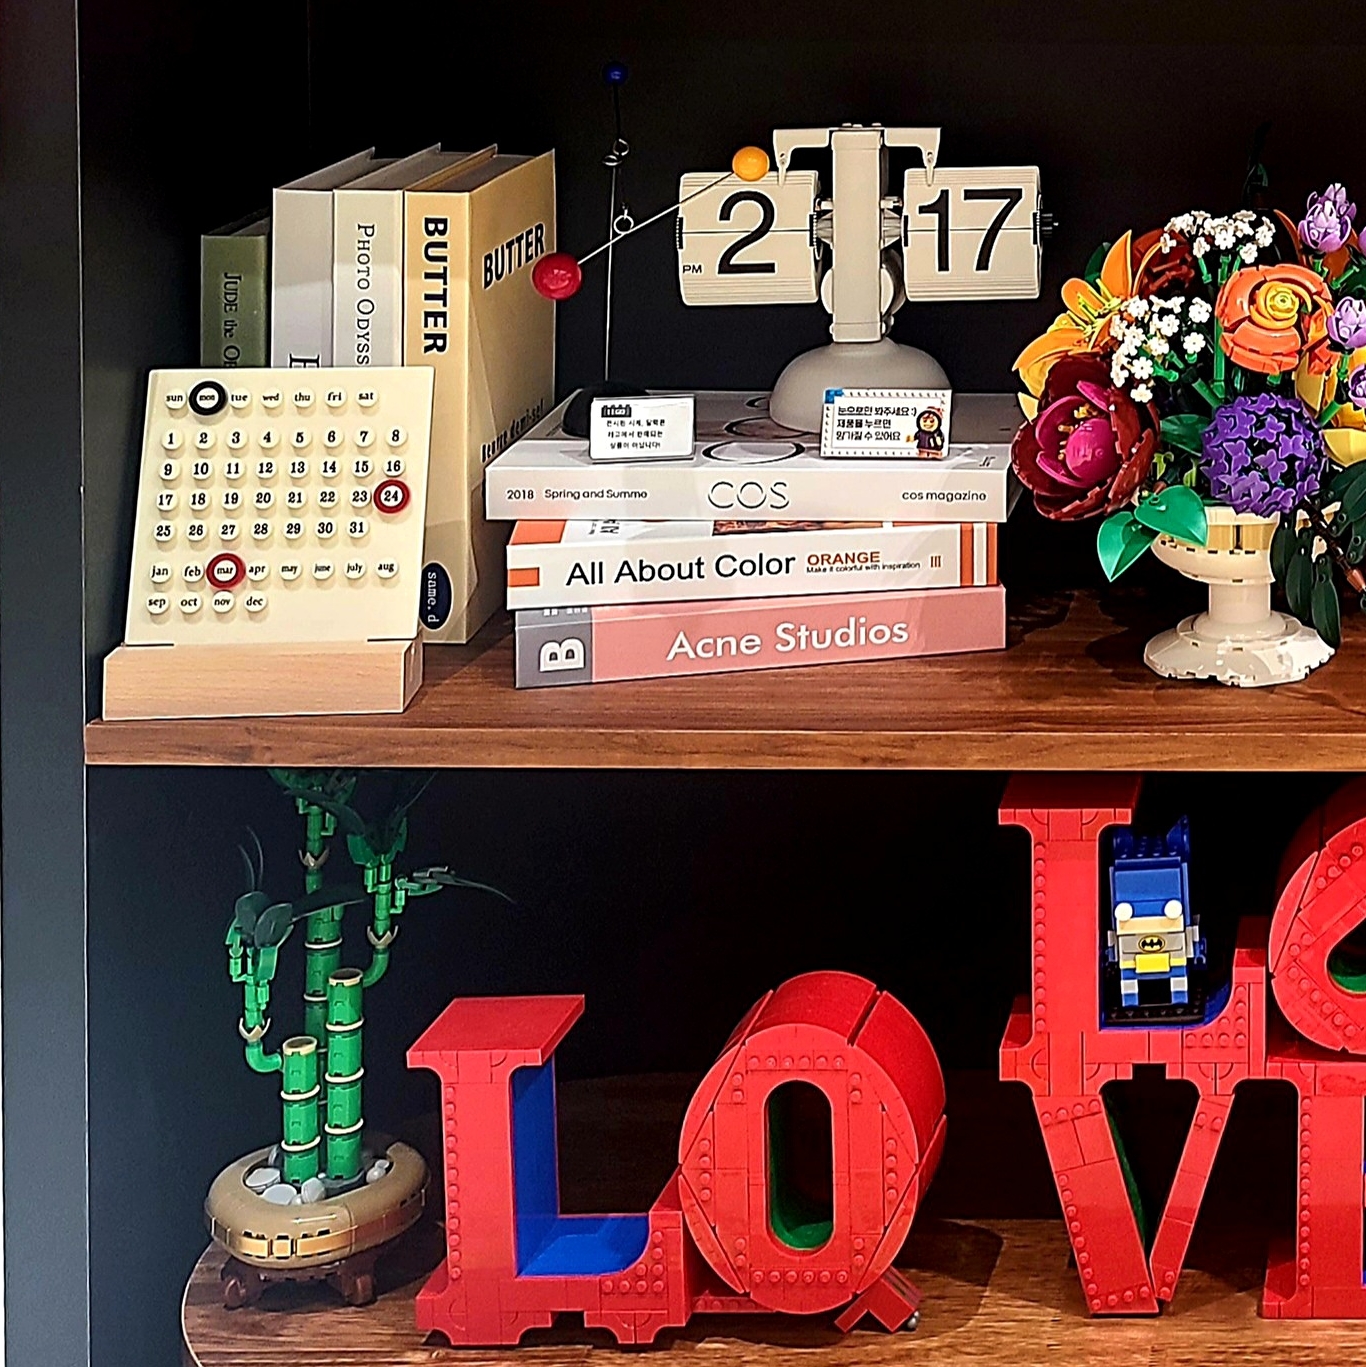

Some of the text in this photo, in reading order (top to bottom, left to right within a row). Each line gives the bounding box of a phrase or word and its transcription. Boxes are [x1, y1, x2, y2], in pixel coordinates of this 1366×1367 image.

[718, 188, 1023, 274] 2 17
[357, 224, 375, 290] PHOTO
[483, 223, 545, 290] BUTTER
[683, 265, 702, 274] PM
[224, 272, 241, 312] JUDE
[424, 217, 448, 354] BUTTER
[224, 320, 237, 338] the
[166, 394, 183, 402] sun
[231, 393, 248, 401] tue
[263, 393, 279, 401] wed
[294, 393, 310, 401] thu
[328, 392, 341, 401] fri
[358, 392, 374, 401] sat
[875, 407, 909, 416] 봐주세요
[865, 419, 891, 428] 누르면
[168, 430, 399, 444] 1 2 3 4 5 6 7 8
[864, 432, 872, 440] 수
[875, 432, 900, 440] 있어요
[164, 461, 400, 476] 9 10 11 12 13 14 15 16
[159, 491, 399, 506] 17 18 19 20 21 22 23 24
[507, 490, 534, 499] 2018
[545, 490, 580, 501] Spring
[582, 490, 604, 498] and
[708, 481, 789, 509] COS
[902, 490, 986, 502] cos magazine
[156, 522, 364, 537] 25 26 27 28 29 30 31
[808, 552, 880, 565] ORANGE
[882, 562, 920, 570] inspiration
[152, 562, 394, 578] jan feb mar apr may june july aug
[566, 553, 796, 585] All About Color
[149, 597, 263, 609] sep oct nov dec
[666, 617, 909, 661] Acne Studios
[540, 638, 585, 672] B
